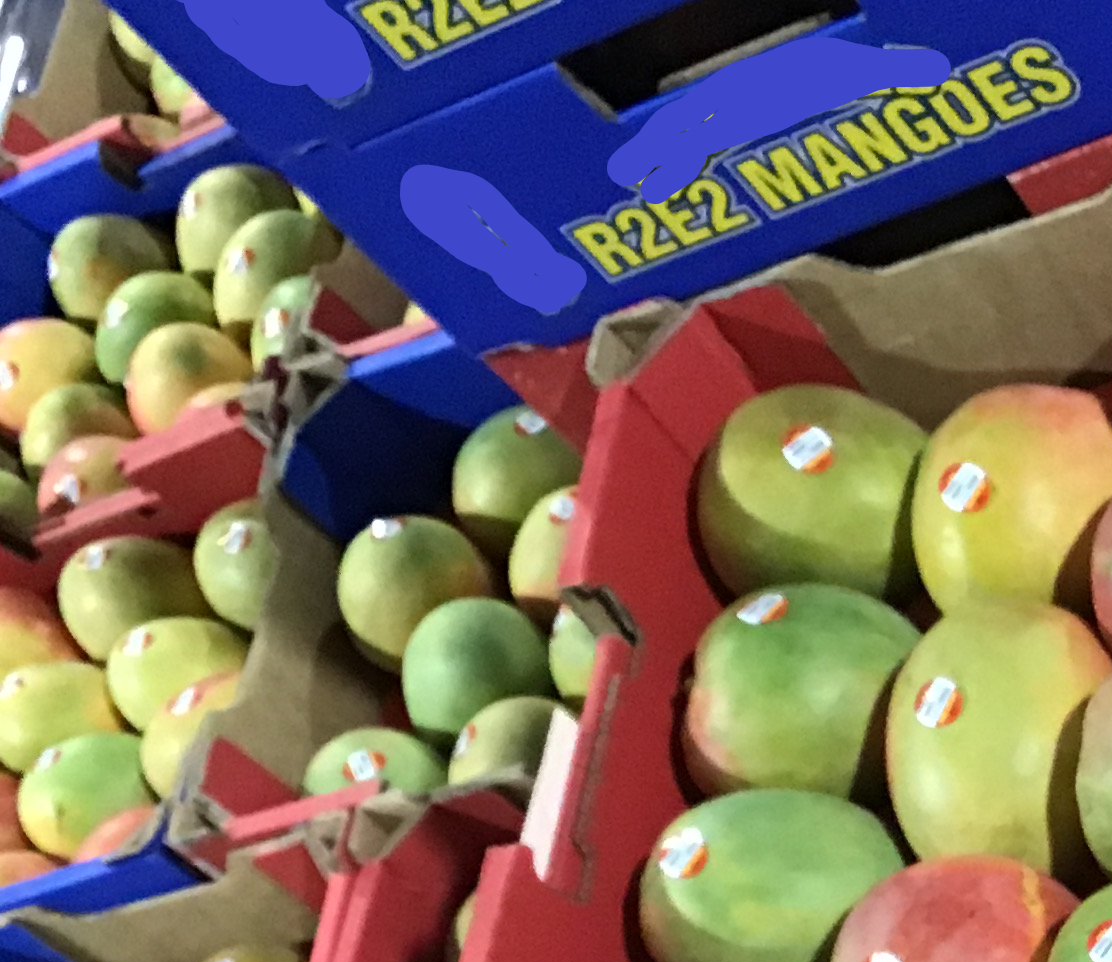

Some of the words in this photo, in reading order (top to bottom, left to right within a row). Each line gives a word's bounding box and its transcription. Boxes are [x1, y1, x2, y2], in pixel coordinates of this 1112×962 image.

[361, 0, 540, 60] R2E
[574, 180, 748, 276] R2E2
[737, 46, 1072, 210] MANGOES
